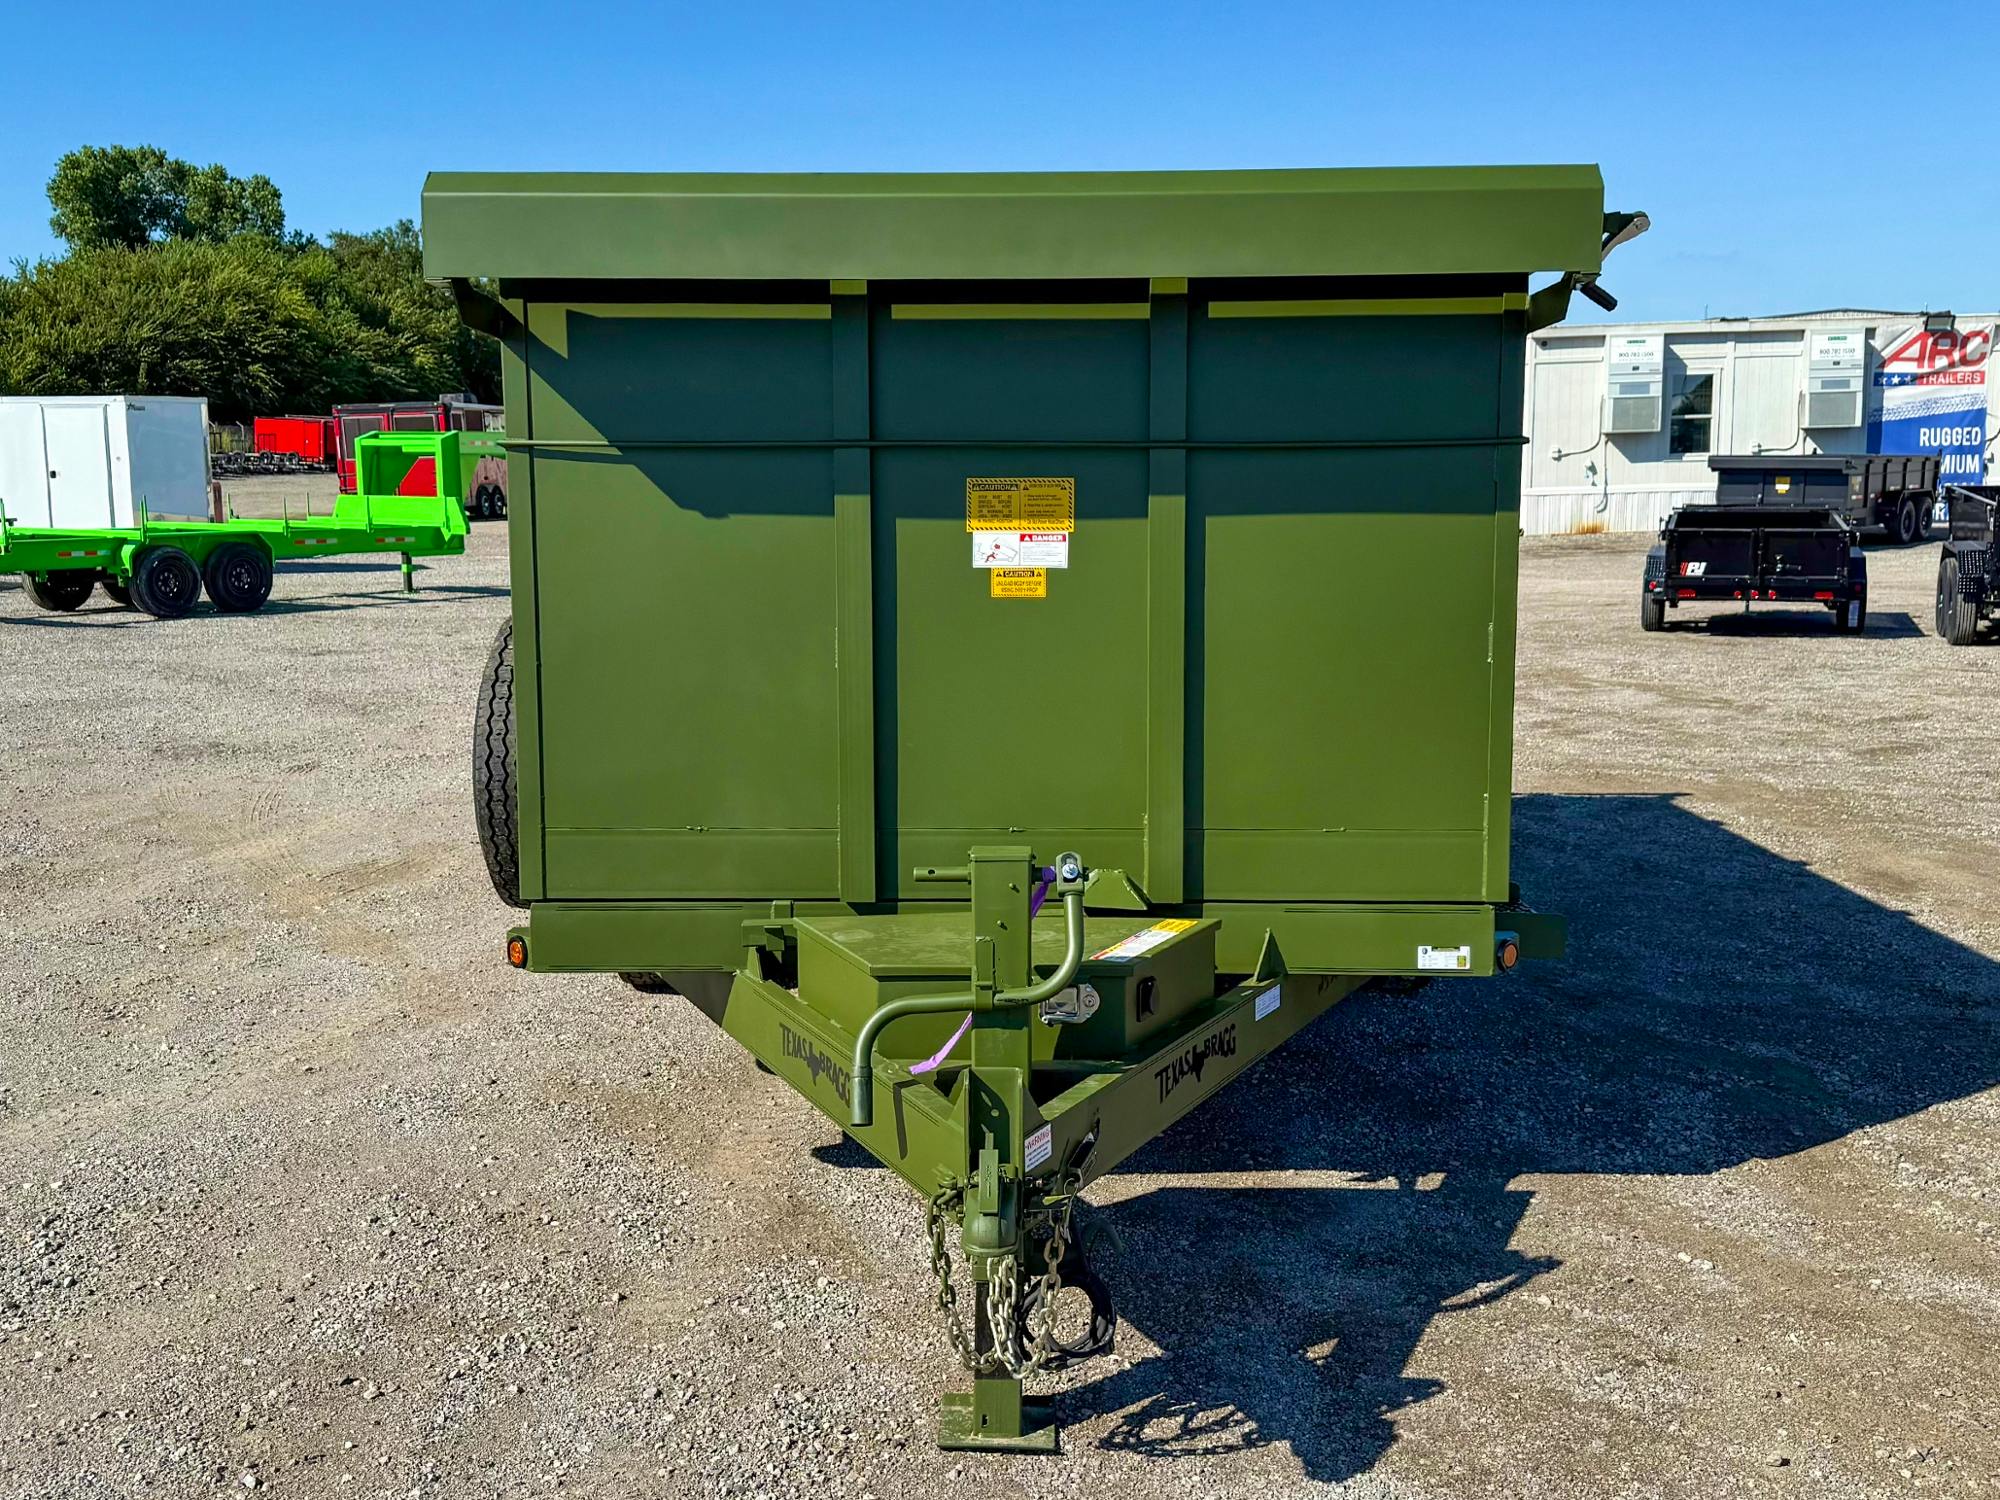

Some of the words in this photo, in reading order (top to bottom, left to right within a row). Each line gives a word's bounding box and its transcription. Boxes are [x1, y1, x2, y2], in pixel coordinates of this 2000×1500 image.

[1876, 330, 1989, 369] ARC
[1922, 372, 1981, 385] TRAILERS
[1920, 427, 1981, 447] RUGGED
[1032, 534, 1062, 542] DANGER
[779, 1022, 808, 1061] TEXAS
[819, 1050, 851, 1108] BRAGG
[1154, 1047, 1192, 1104] TEXAS
[1203, 1023, 1236, 1059] BRAGG
[1025, 1129, 1050, 1150] WARNING
